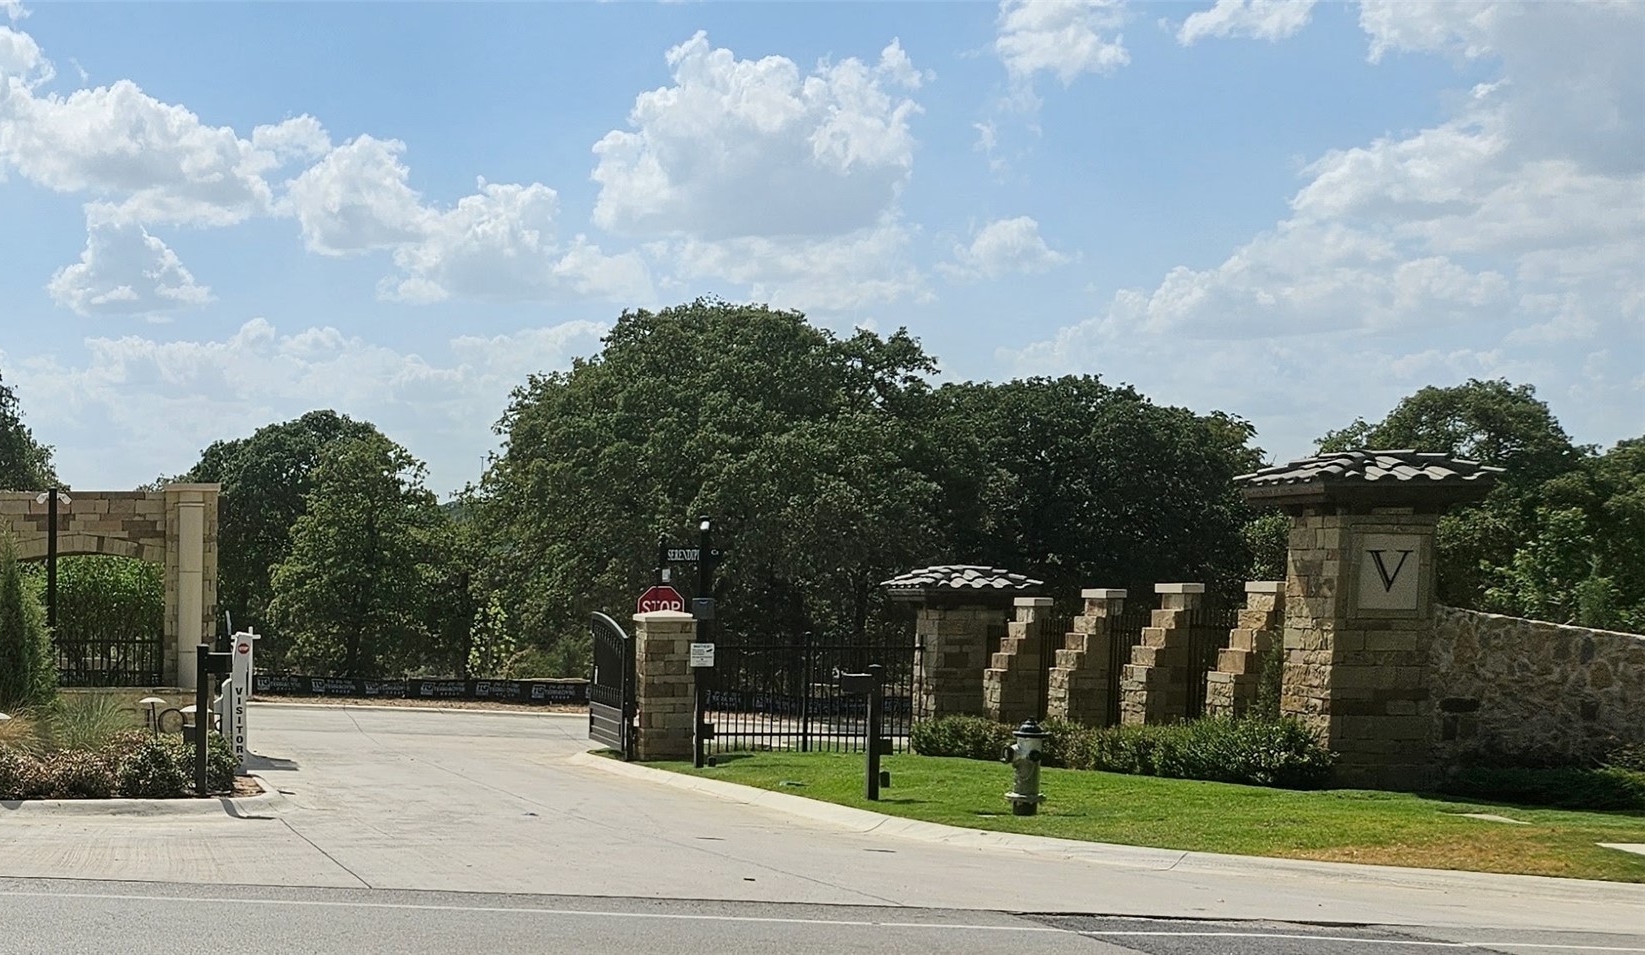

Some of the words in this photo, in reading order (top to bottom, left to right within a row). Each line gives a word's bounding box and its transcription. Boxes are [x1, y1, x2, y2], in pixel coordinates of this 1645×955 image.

[1365, 549, 1414, 593] V
[642, 600, 681, 613] STOP
[236, 687, 244, 765] VISITORS
